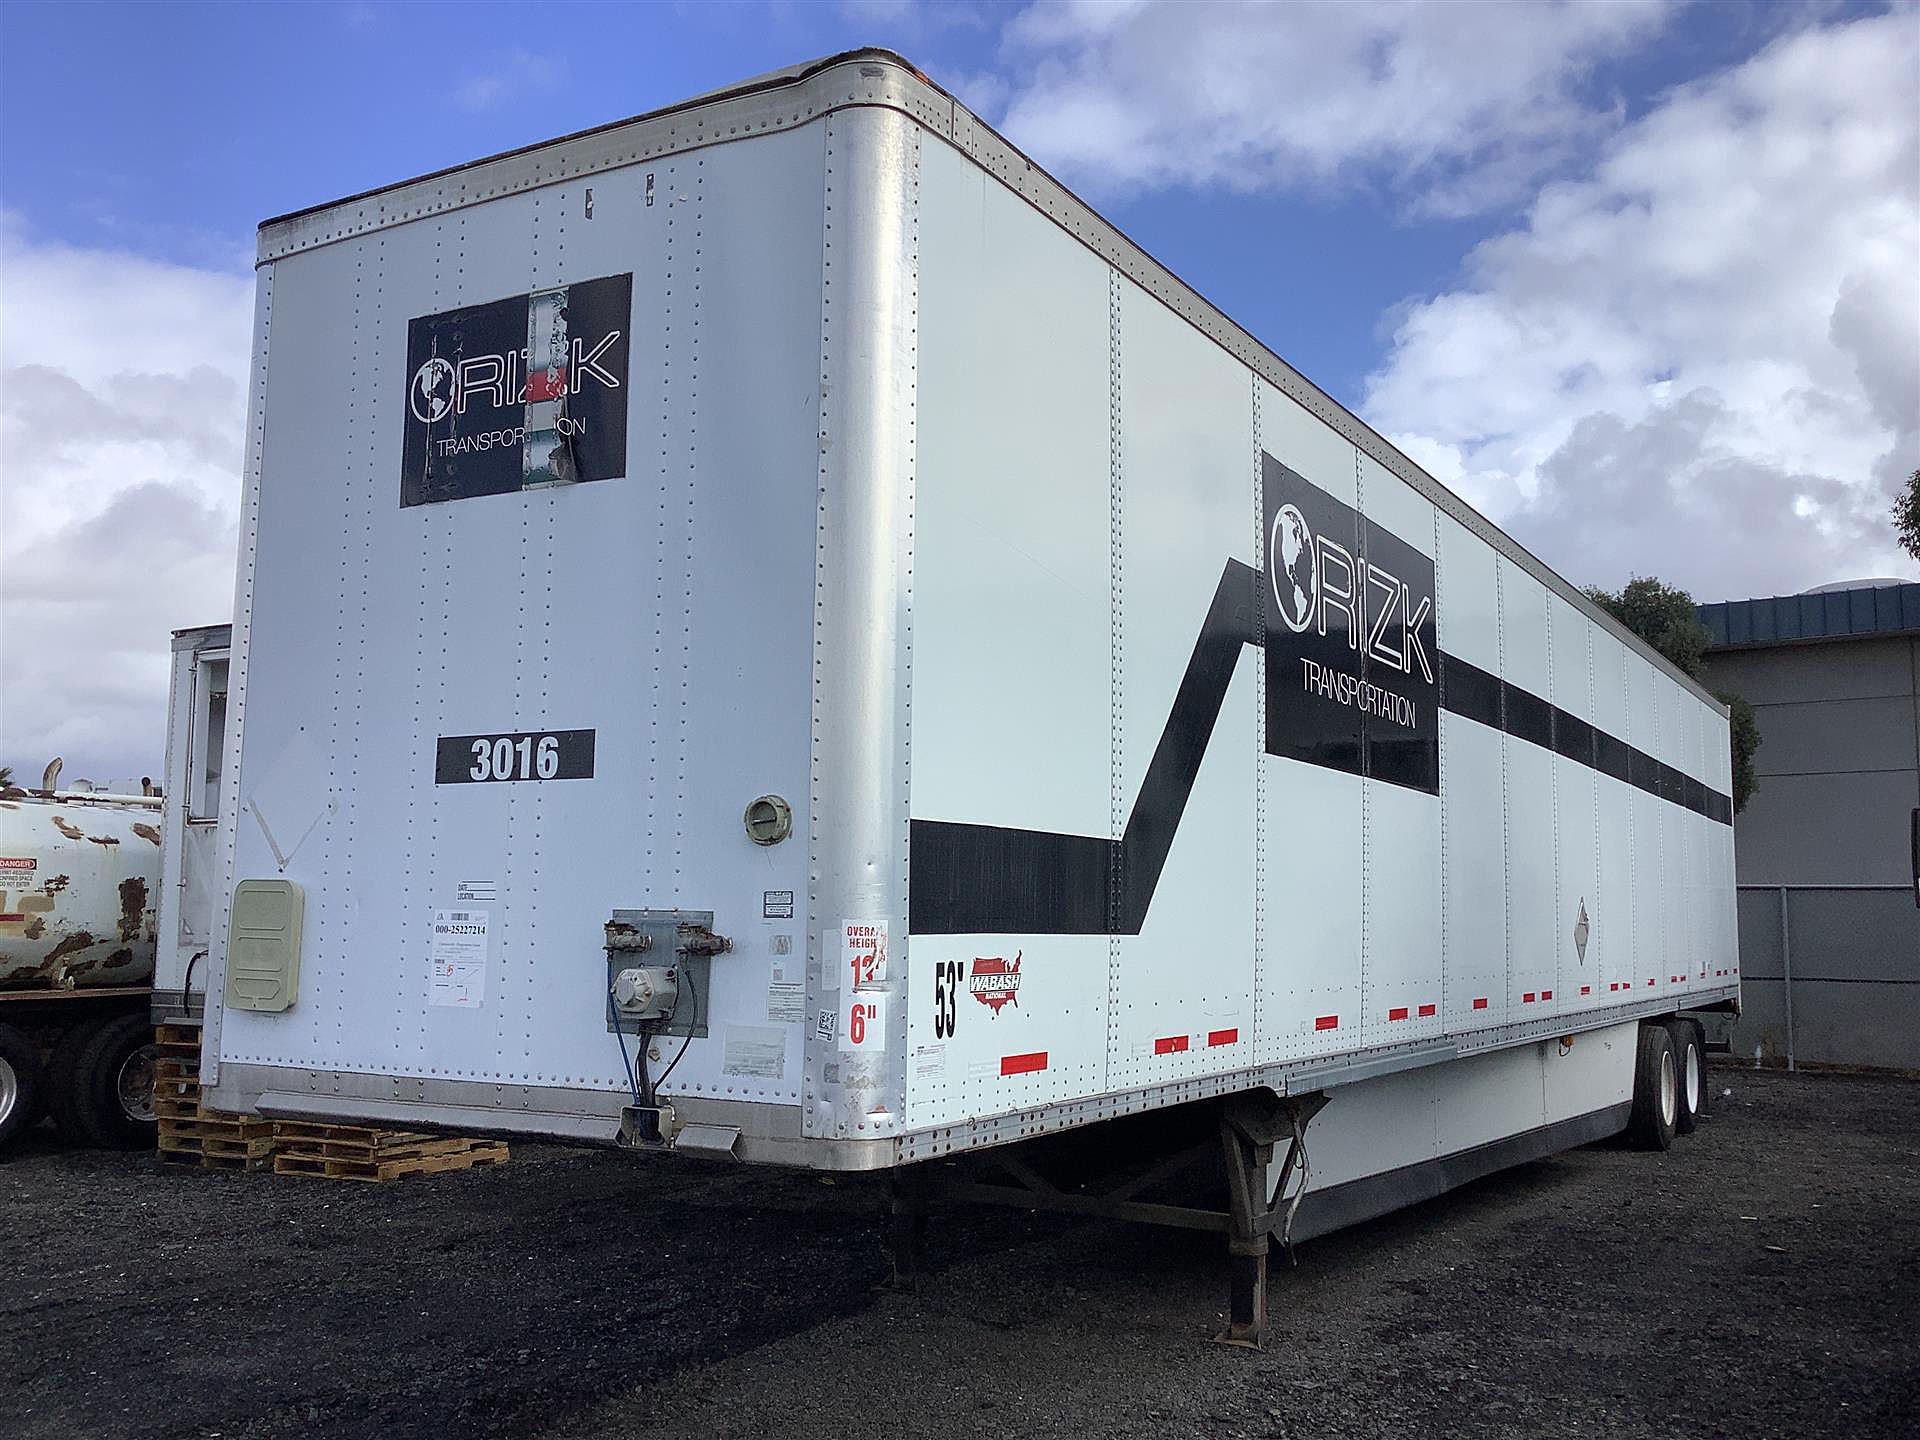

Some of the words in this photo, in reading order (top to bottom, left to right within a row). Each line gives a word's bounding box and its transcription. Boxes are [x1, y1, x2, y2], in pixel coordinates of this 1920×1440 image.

[410, 330, 621, 424] ORIK
[1270, 503, 1434, 684] ORIZK
[1299, 656, 1417, 729] TRANSPORTATION
[469, 735, 559, 781] 3016
[0, 860, 31, 868] DANGER
[457, 892, 474, 900] LOCATION
[435, 924, 486, 935] 000-25227214
[849, 938, 877, 948] HEIGH
[935, 960, 964, 1040] 53'
[970, 974, 1021, 992] WABASH
[850, 1004, 876, 1045] 6"
